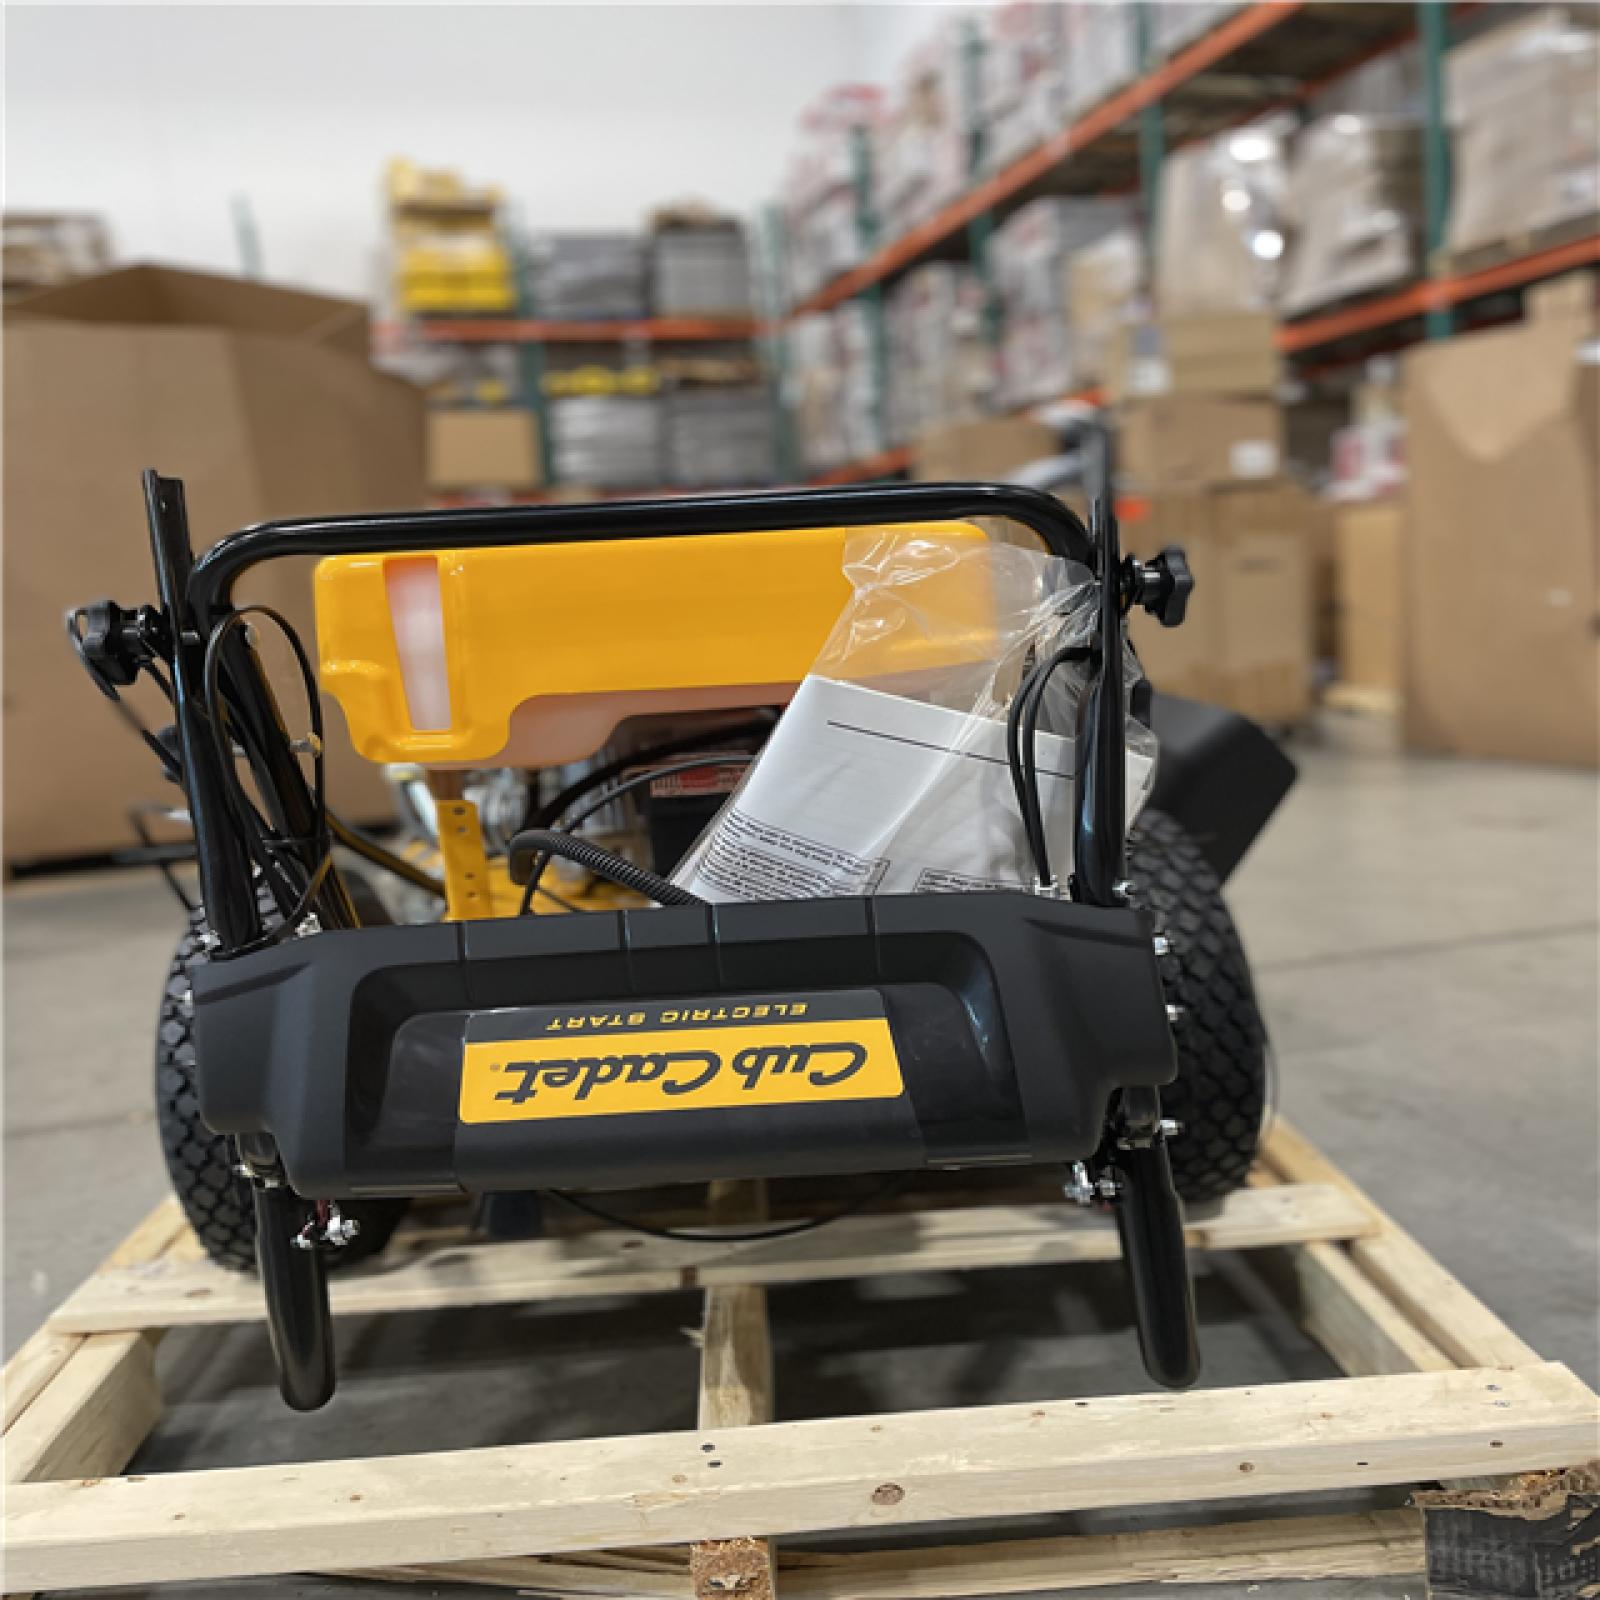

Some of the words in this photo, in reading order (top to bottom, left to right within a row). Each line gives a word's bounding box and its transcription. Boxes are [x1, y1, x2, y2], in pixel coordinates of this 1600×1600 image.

[545, 1012, 646, 1031] START
[660, 1003, 807, 1021] ELECTRIC
[495, 1051, 721, 1103] Cadet
[732, 1043, 867, 1089] Cub
